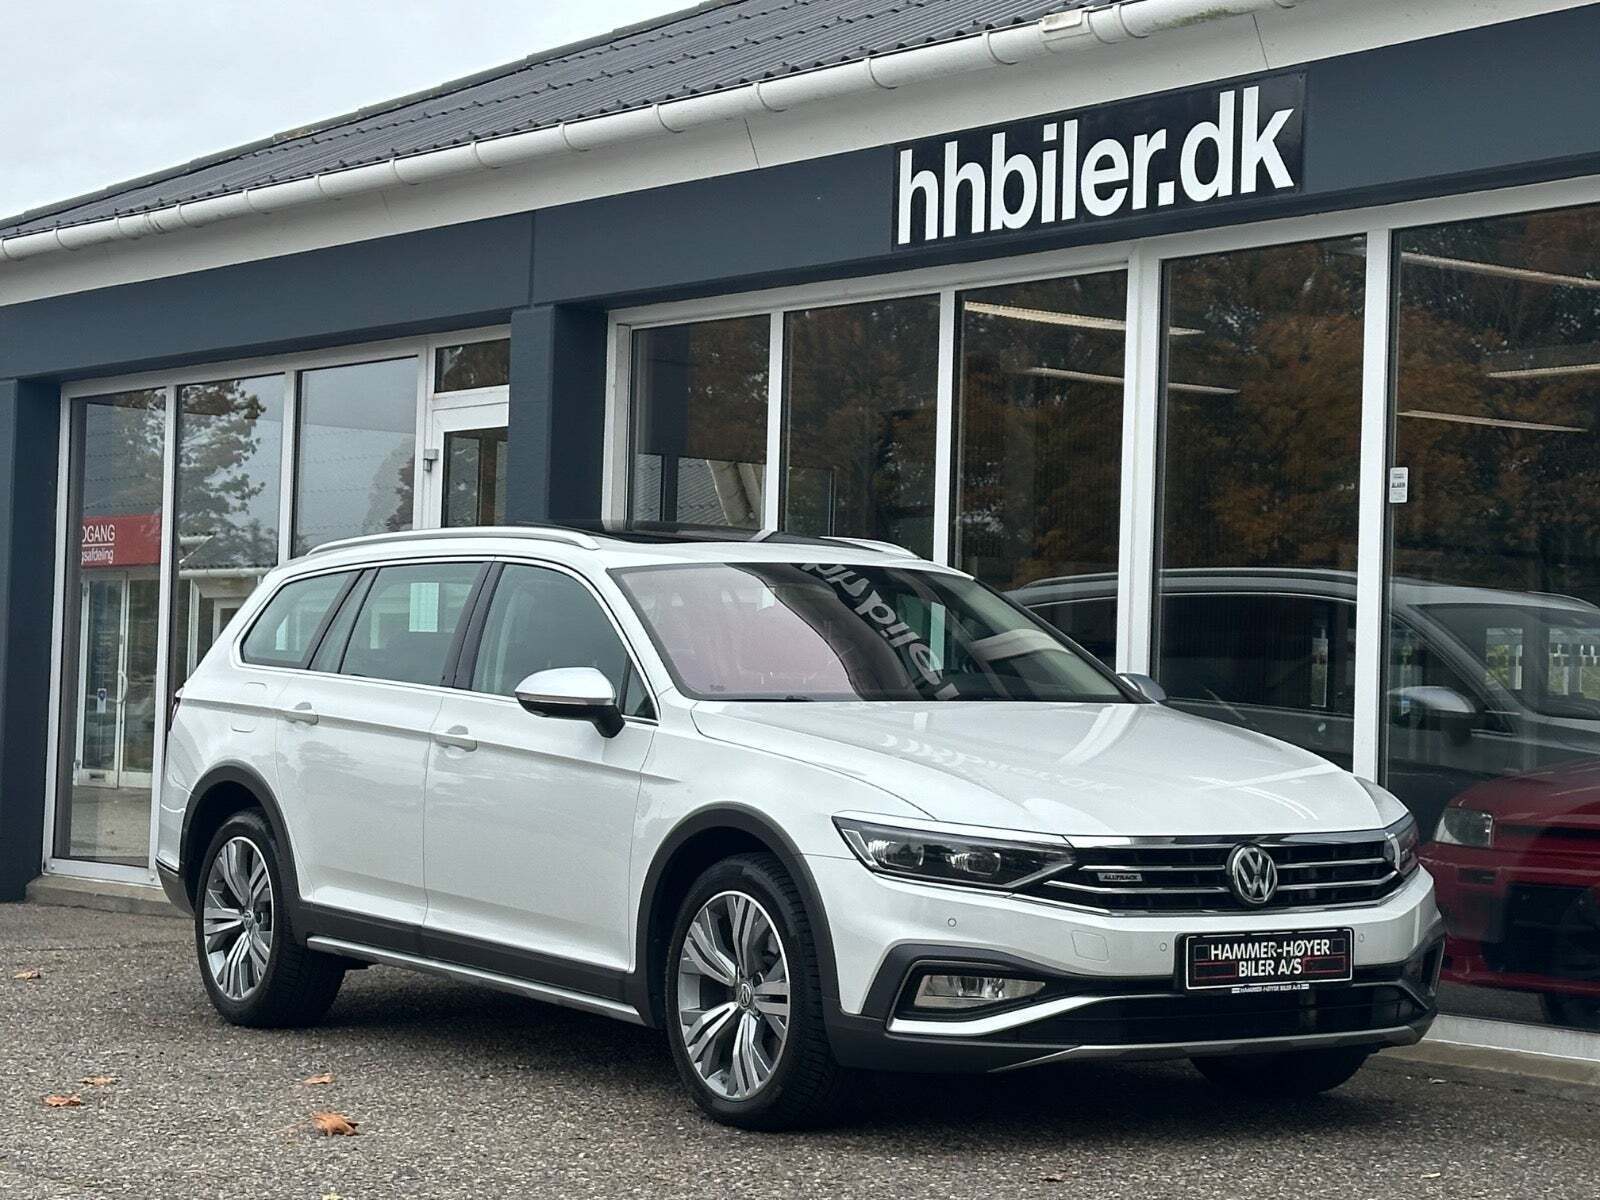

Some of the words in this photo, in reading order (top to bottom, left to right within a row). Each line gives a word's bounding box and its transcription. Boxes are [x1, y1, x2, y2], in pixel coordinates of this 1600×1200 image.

[898, 86, 1294, 244] hhbiler.dk
[1211, 939, 1330, 960] HAMMER-HØYER
[1239, 960, 1275, 977] BILER
[1278, 958, 1302, 976] A/S
